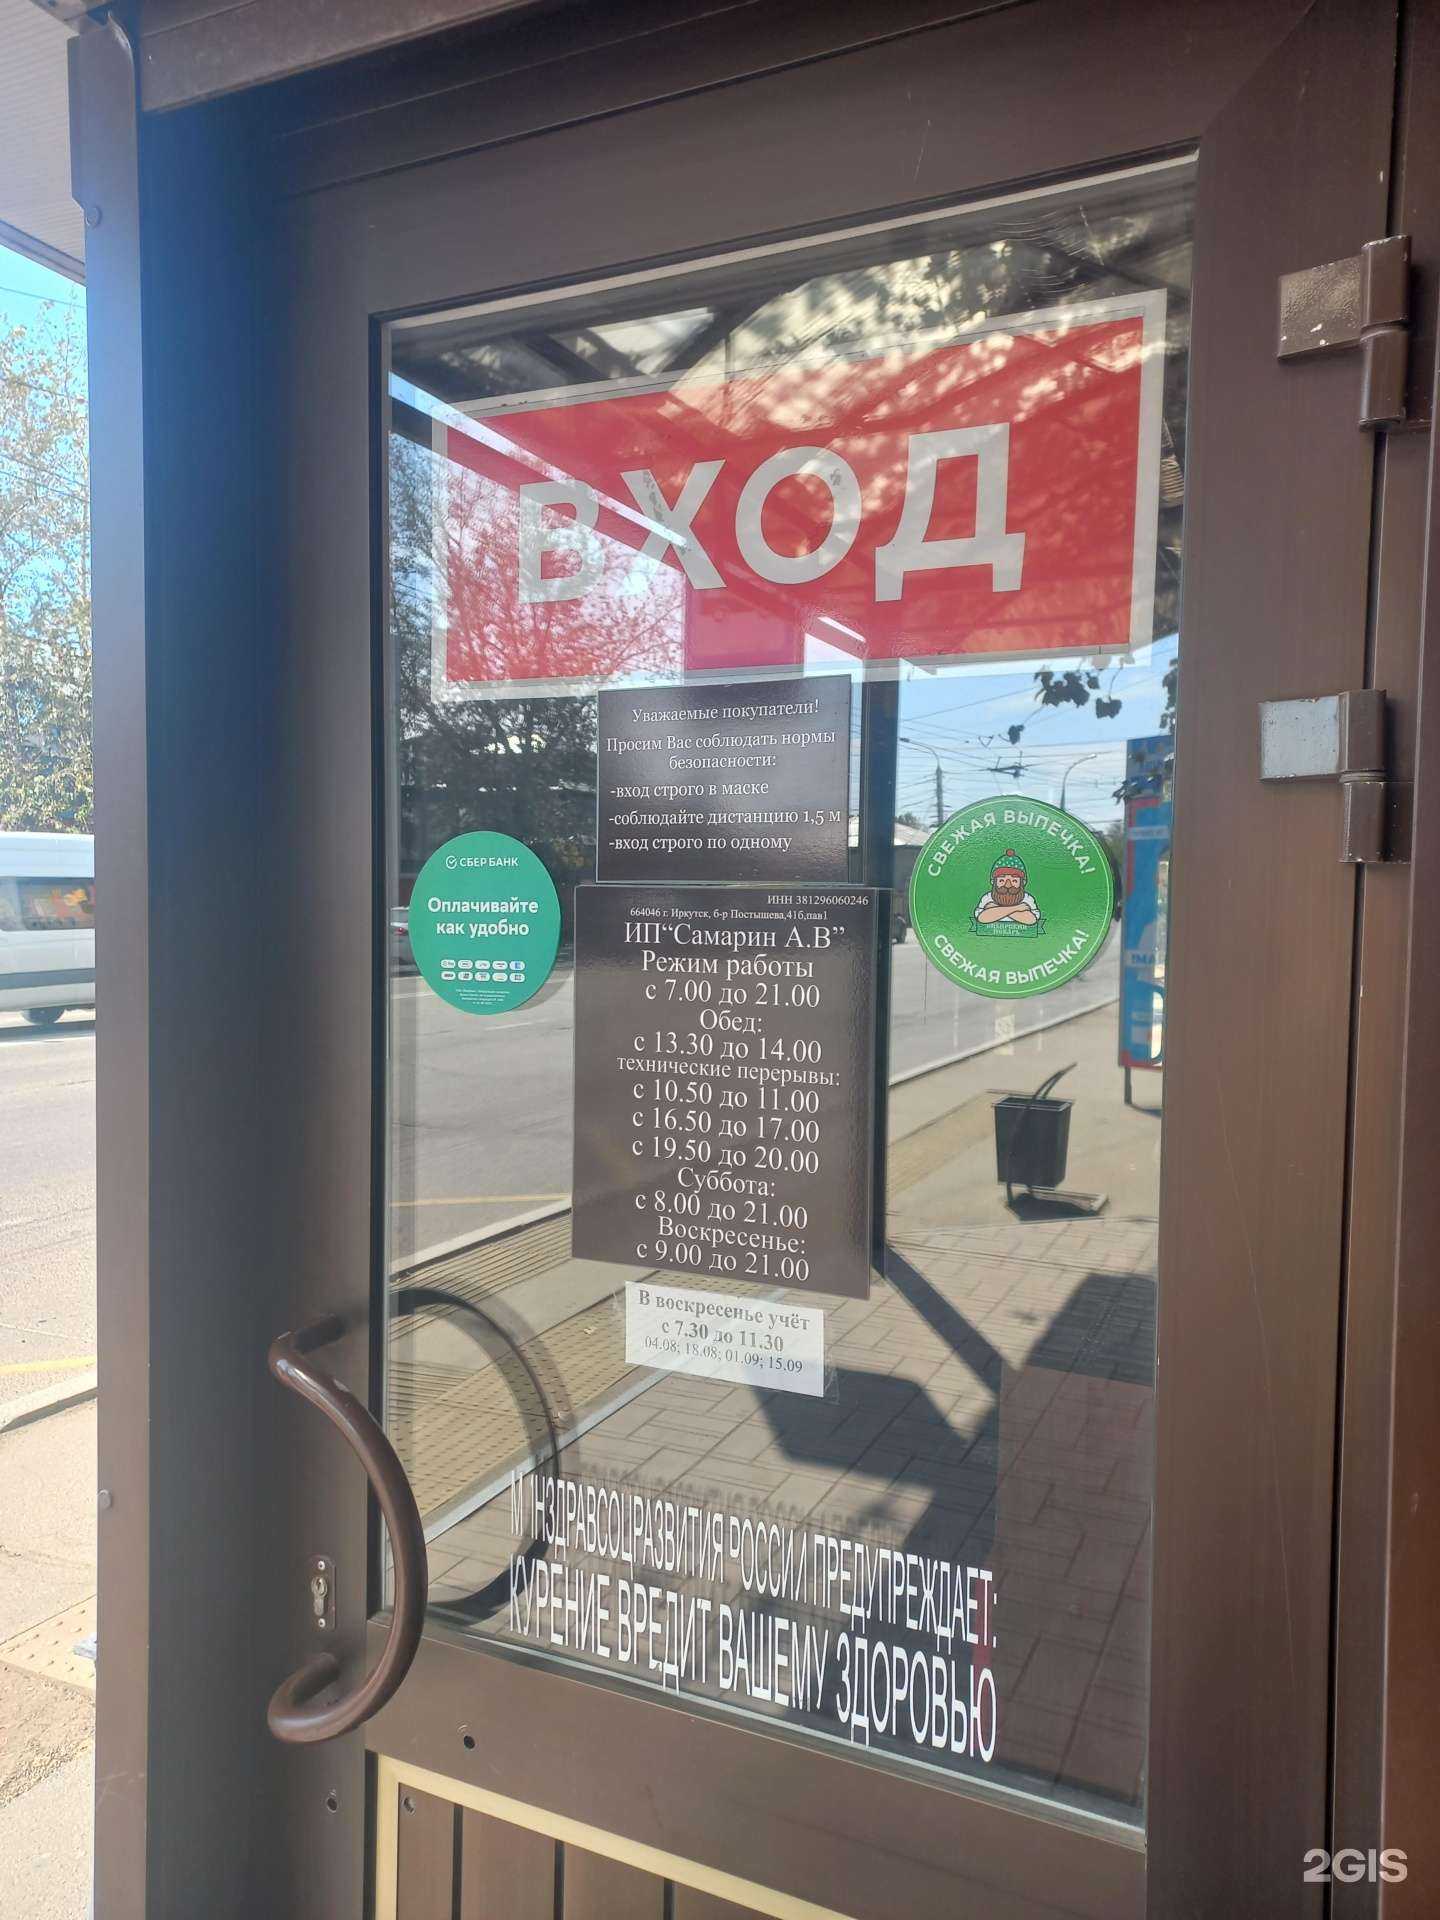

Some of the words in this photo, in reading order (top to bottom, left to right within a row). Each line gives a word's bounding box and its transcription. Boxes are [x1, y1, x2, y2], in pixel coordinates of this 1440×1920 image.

[517, 422, 1025, 603] ВХОД
[632, 706, 718, 723] Уважаемые
[722, 699, 819, 721] покупатели!
[606, 737, 662, 753] Просим
[666, 735, 692, 750] Вас
[695, 733, 777, 749] соблюдать
[781, 731, 835, 750] нормы
[669, 755, 776, 770] безопасности:
[610, 784, 650, 799] -вход
[654, 783, 704, 801] строго
[708, 785, 718, 796] в
[721, 782, 769, 796] маске
[609, 809, 704, 826] -соблюдайте
[707, 811, 798, 826] дистанцию
[803, 810, 824, 826] 1,5
[828, 810, 841, 822] м
[609, 837, 649, 852] -вход
[652, 837, 703, 852] строго
[707, 837, 726, 850] по
[730, 836, 793, 852] одному
[928, 811, 996, 877] СВЕЖАЯ
[1003, 809, 1096, 875] ВЫПЕЧКА!
[427, 896, 539, 914] Оплачивайте
[630, 908, 661, 918] 664046
[671, 908, 712, 920] Иркутск,
[713, 909, 728, 920] б-р
[768, 895, 793, 906] ИНН
[436, 922, 465, 935] как
[468, 919, 530, 938] удобно
[641, 950, 719, 975] Режим
[726, 954, 814, 980] работы
[934, 933, 1001, 984] СВЕЖАЯ
[1005, 928, 1090, 986] ВЫПЕЧКА!
[645, 983, 656, 1000] с
[665, 979, 712, 1002] 7.00
[719, 986, 747, 1006] до
[755, 982, 820, 1008] 21.00
[699, 1008, 763, 1033] Обед:
[634, 1035, 645, 1052] с
[654, 1031, 713, 1056] 13.30
[720, 1040, 748, 1060] до
[759, 1038, 822, 1063] 14.00
[616, 1055, 731, 1078] технические
[737, 1063, 840, 1087] перерывы:
[633, 1082, 644, 1099] с
[653, 1079, 712, 1105] 10.50
[719, 1090, 748, 1109] до
[758, 1088, 819, 1114] 11.00
[632, 1111, 644, 1127] с
[653, 1107, 712, 1133] 16.50
[718, 1119, 747, 1137] до
[757, 1116, 820, 1143] 17.00
[632, 1140, 643, 1156] с
[653, 1136, 711, 1163] 19.50
[718, 1149, 746, 1168] до
[754, 1146, 819, 1174] 20.00
[677, 1166, 775, 1197] Суббота:
[635, 1194, 646, 1210] с
[654, 1190, 700, 1216] 8.00
[707, 1202, 736, 1221] до
[743, 1200, 808, 1230] 21.00
[658, 1215, 806, 1254] Воскресенье:
[637, 1242, 648, 1258] с
[655, 1240, 702, 1266] 9.00
[708, 1253, 737, 1272] до
[744, 1252, 809, 1281] 21.00
[639, 1289, 650, 1306] В
[655, 1296, 764, 1324] воскресенье
[768, 1312, 811, 1331] учёт
[661, 1321, 670, 1334] с
[674, 1320, 709, 1340] 7.30
[712, 1331, 733, 1344] до
[739, 1330, 784, 1352] 11.30
[725, 1348, 764, 1369] 01.09;
[768, 1355, 803, 1373] 15.09
[729, 1515, 807, 1604] РОССИИ
[813, 1532, 998, 1655] ПРЕДУПРЕЖДАЕТ:
[510, 1553, 611, 1658] КУРЕНИЕ
[618, 1579, 711, 1696] ВРЕДИТ
[719, 1603, 829, 1713] ВАШЕМУ
[836, 1632, 997, 1762] ЗДОРОВЬЮ
